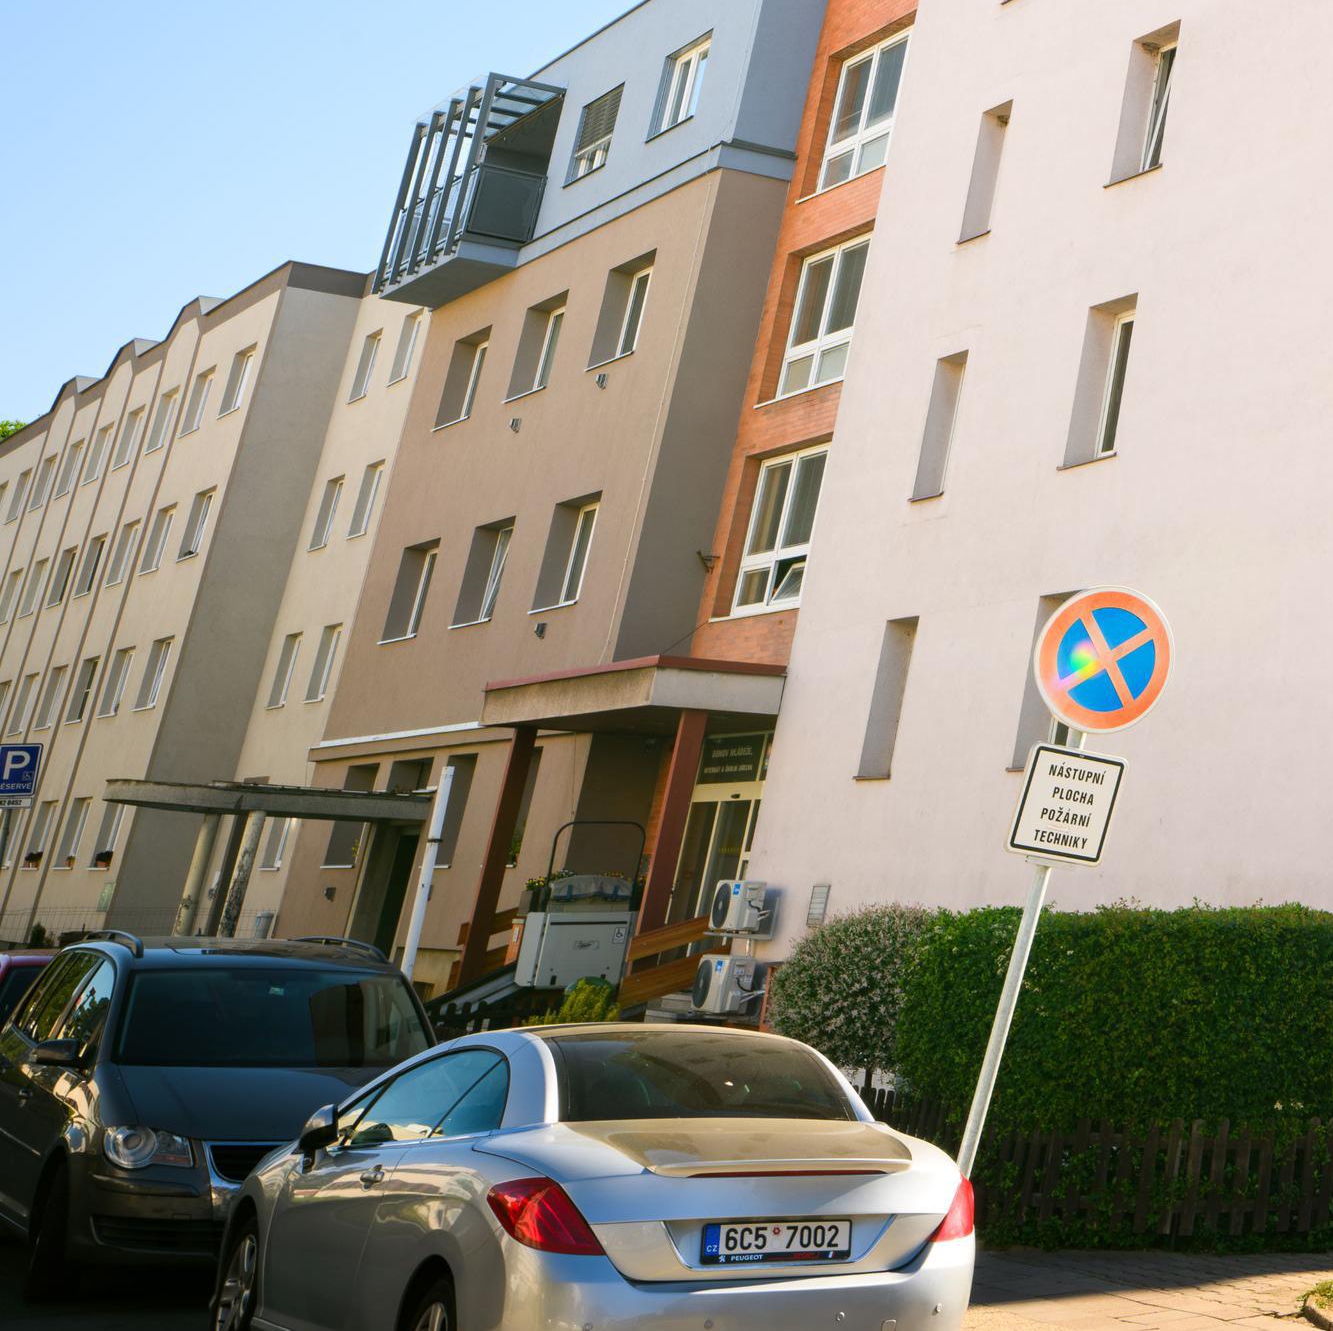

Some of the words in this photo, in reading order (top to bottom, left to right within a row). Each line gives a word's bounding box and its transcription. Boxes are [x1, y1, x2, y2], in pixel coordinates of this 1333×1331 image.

[3, 751, 31, 780] P
[1049, 761, 1107, 785] NÁSTUPNÍ
[1052, 786, 1095, 805] PLOCHA
[1040, 806, 1092, 827] POŽÁRNÍ
[1034, 829, 1088, 849] TECHNIKY
[706, 1244, 718, 1253] CZ
[725, 1226, 768, 1251] 6C5
[785, 1225, 840, 1249] 7002
